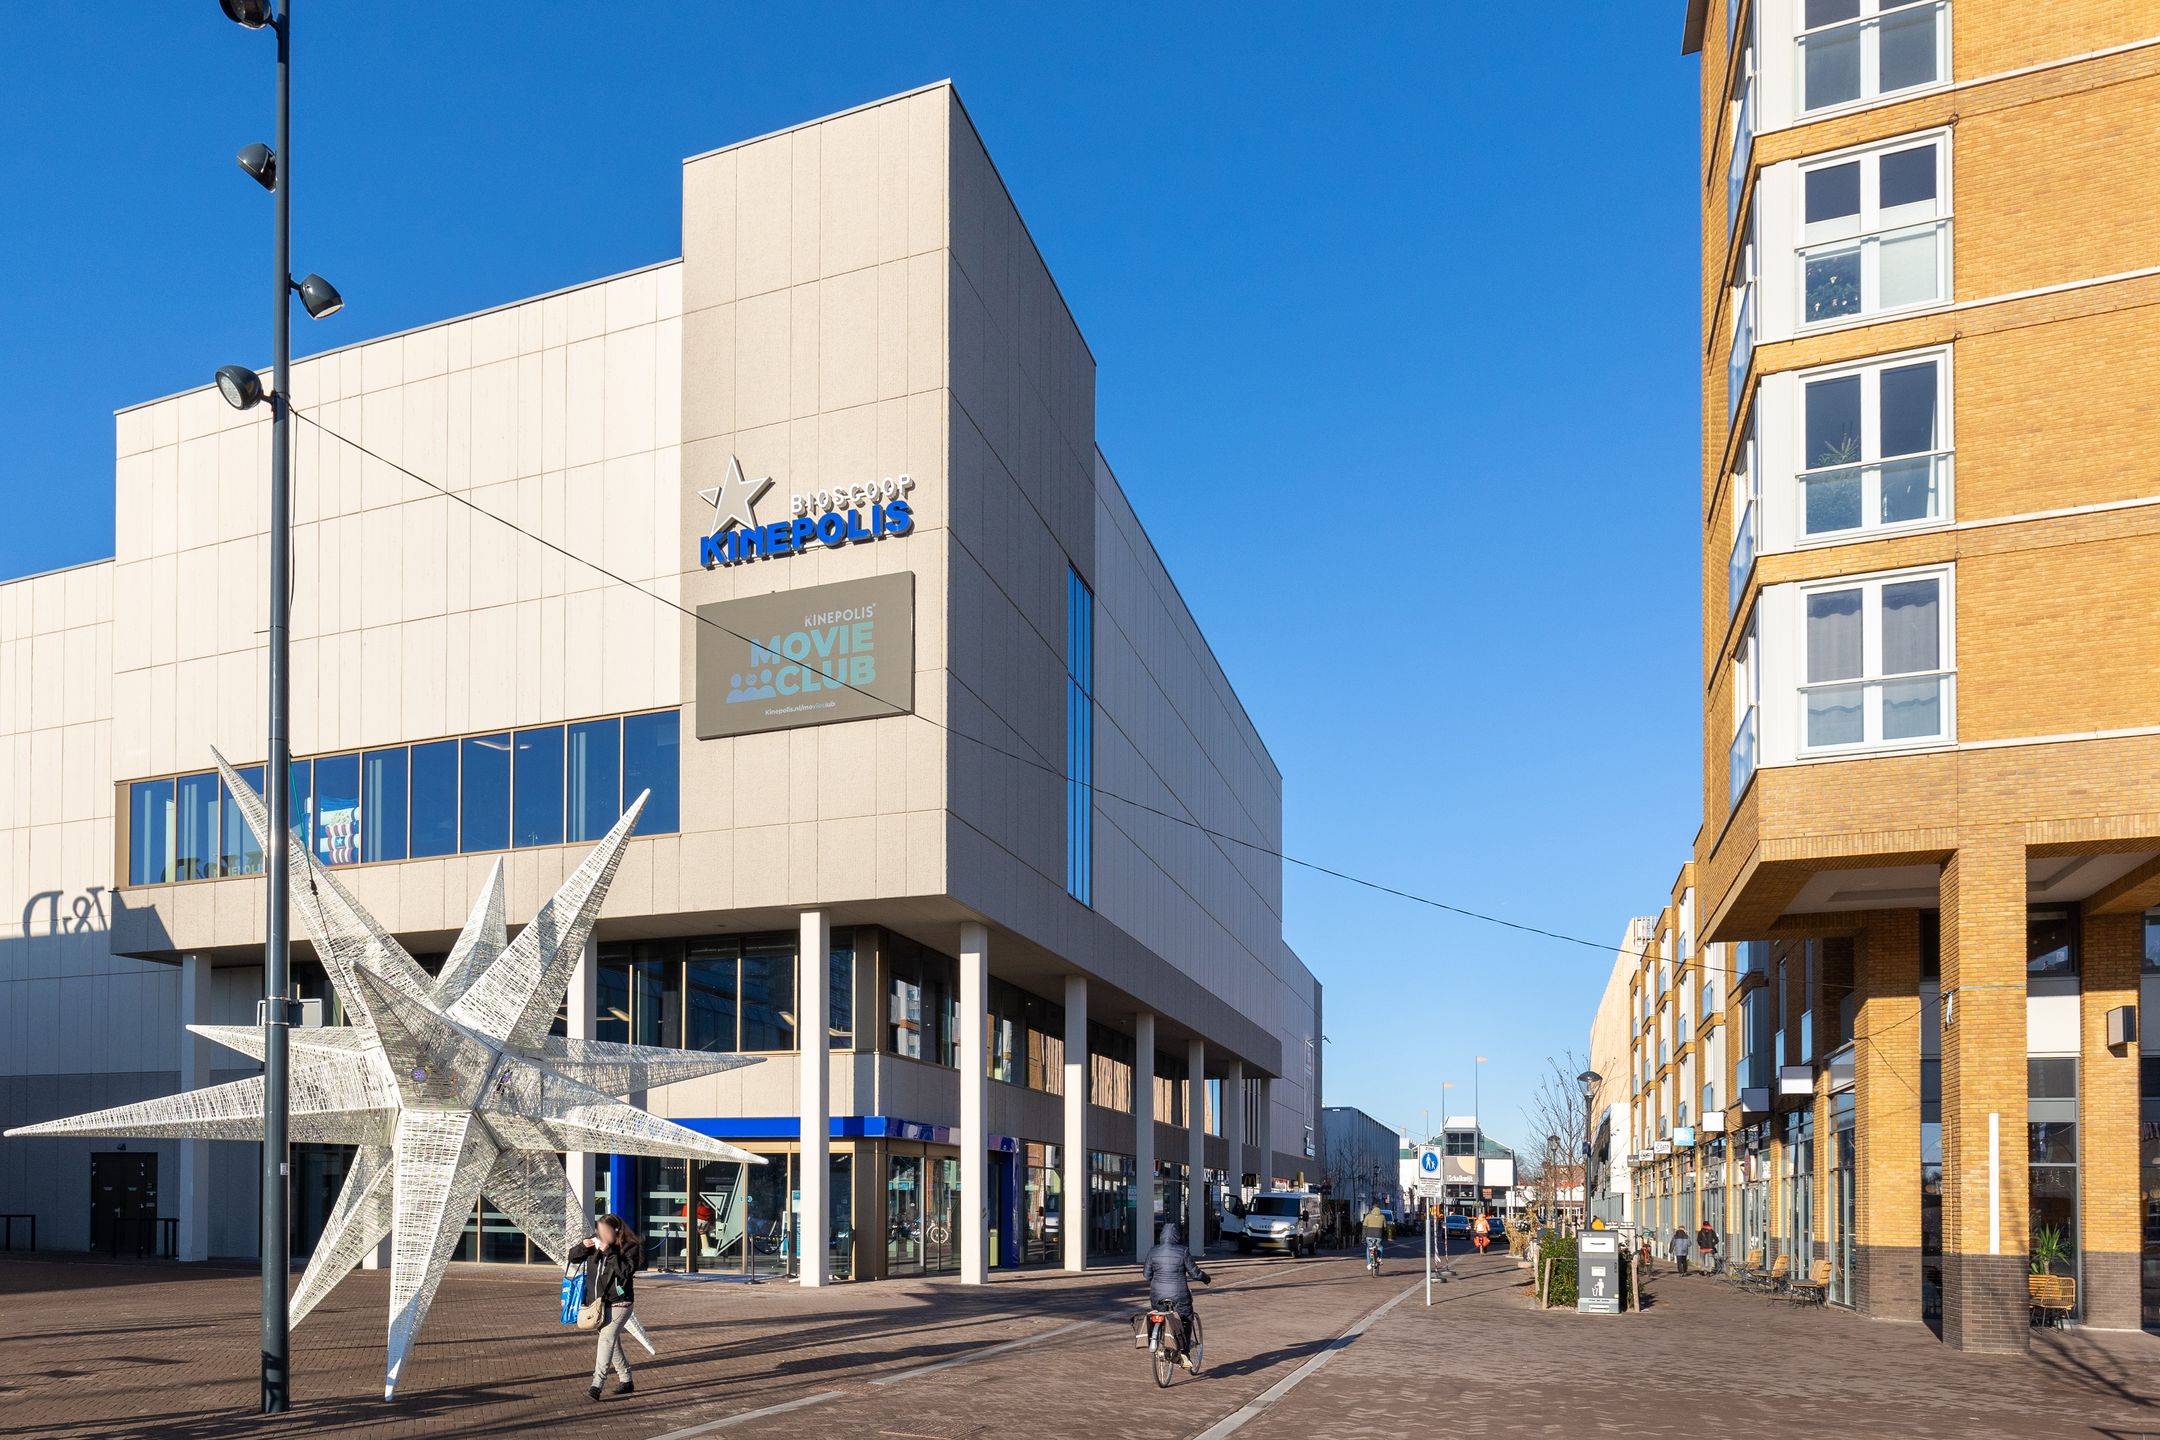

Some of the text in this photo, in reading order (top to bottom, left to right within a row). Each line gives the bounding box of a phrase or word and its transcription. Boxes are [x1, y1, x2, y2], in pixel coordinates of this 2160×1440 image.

[791, 473, 913, 516] BIOSCOOP
[699, 499, 914, 568] KINEPOLIS
[804, 605, 875, 628] KINEPOLIS
[750, 621, 874, 669] MOVIE
[774, 655, 877, 697] CLUB
